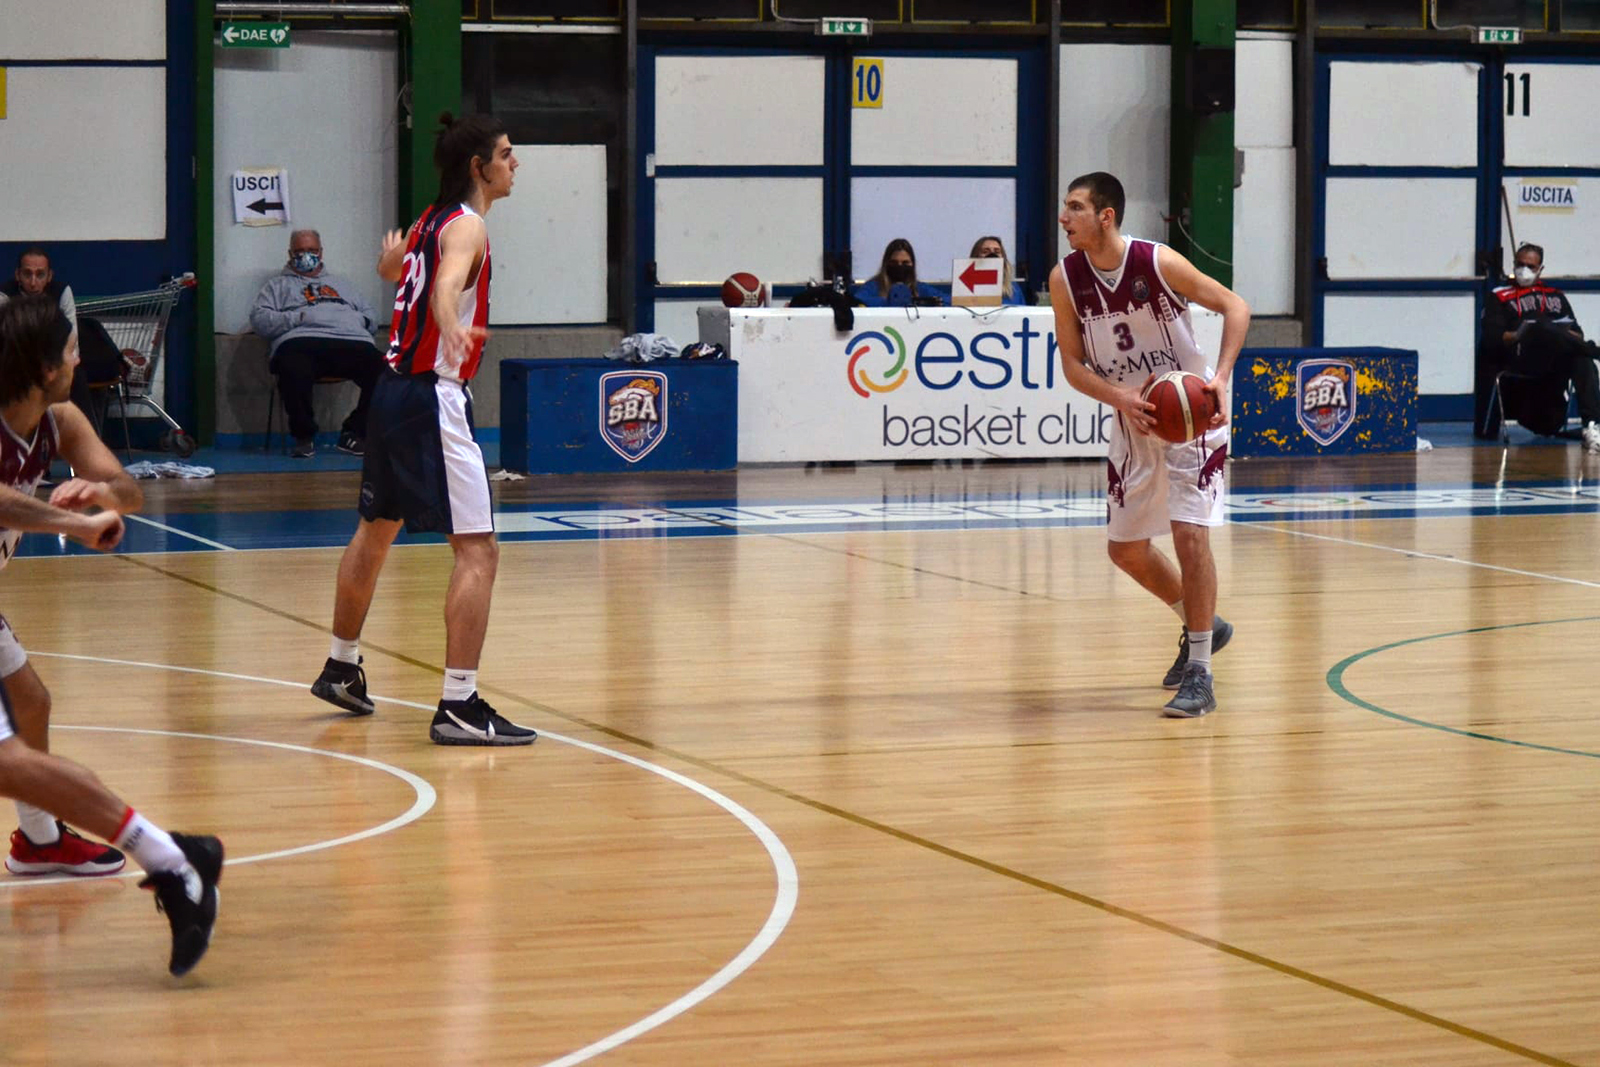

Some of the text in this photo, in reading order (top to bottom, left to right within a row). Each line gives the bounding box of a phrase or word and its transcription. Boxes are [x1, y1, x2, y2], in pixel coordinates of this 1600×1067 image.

[240, 29, 268, 40] DAE
[856, 64, 881, 102] 10
[1504, 73, 1530, 116] 11
[235, 175, 280, 191] USCIT
[1522, 186, 1573, 204] USCITA
[393, 251, 426, 312] 29
[1113, 322, 1135, 352] 3
[915, 317, 1059, 390] estr
[607, 395, 659, 426] SBA
[1303, 381, 1348, 411] SBA
[883, 403, 1027, 447] basket
